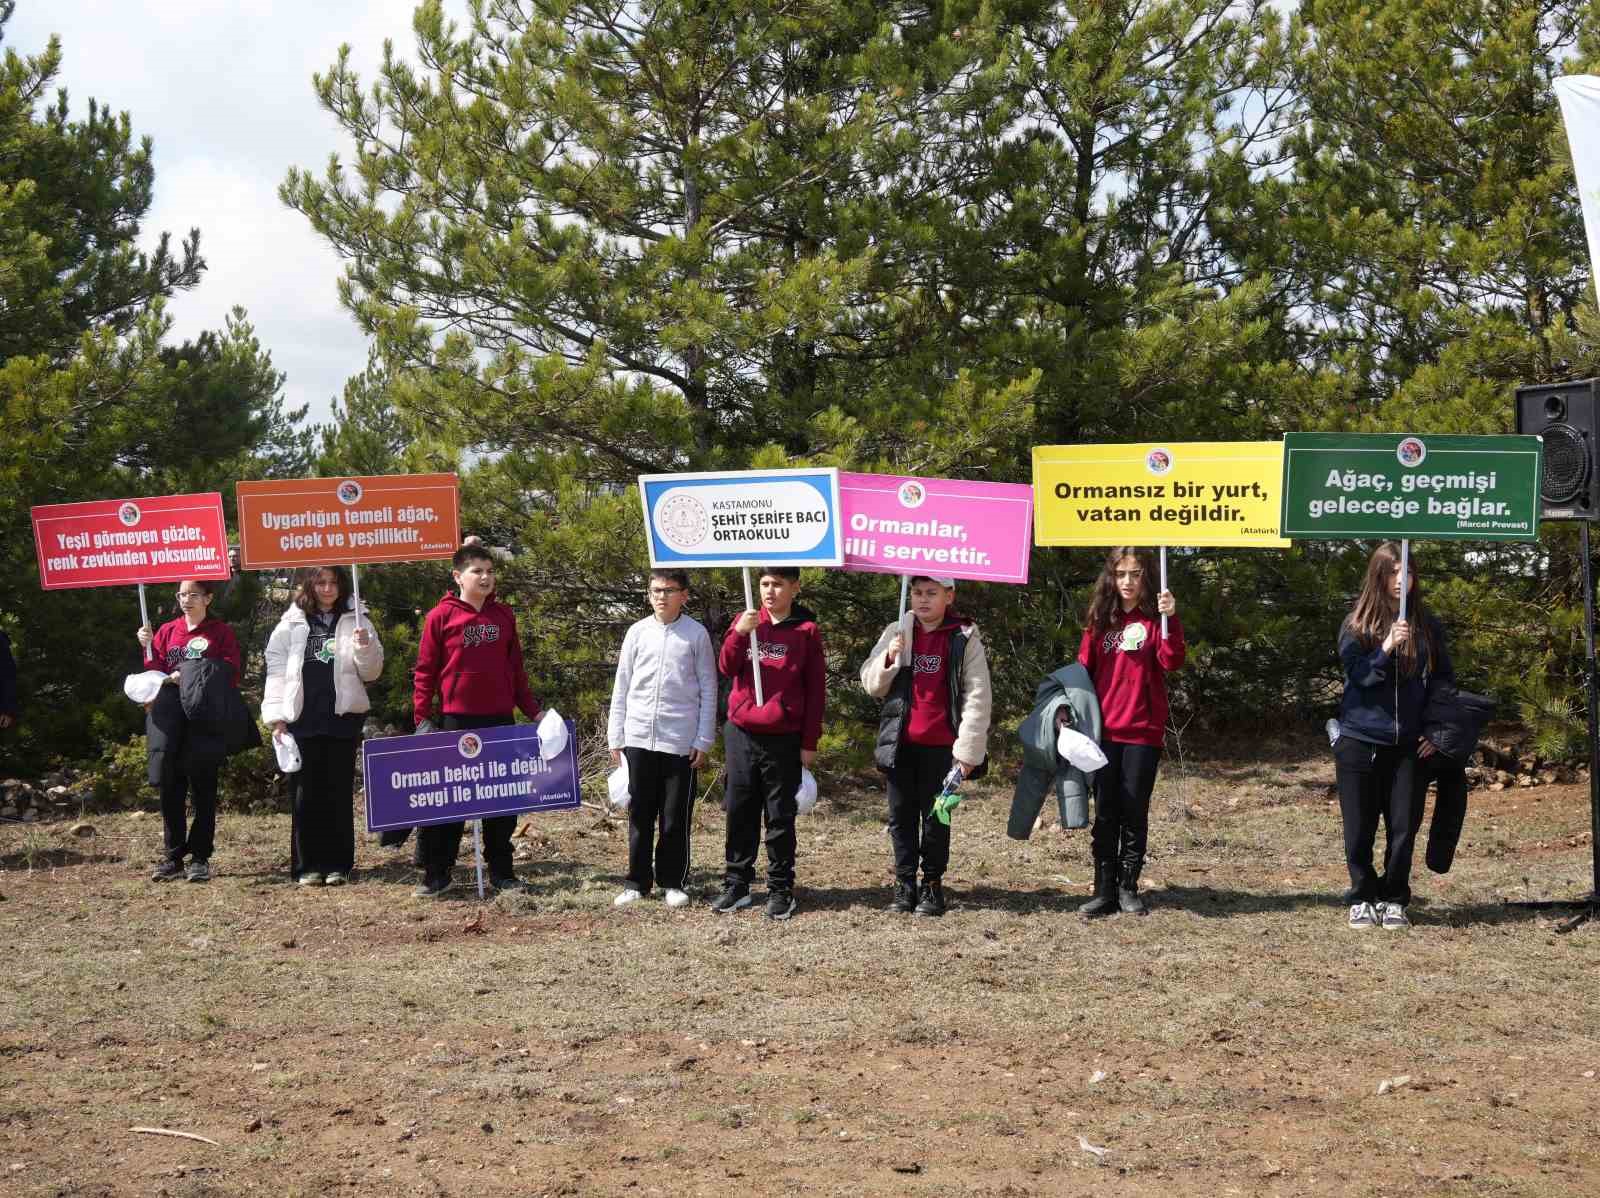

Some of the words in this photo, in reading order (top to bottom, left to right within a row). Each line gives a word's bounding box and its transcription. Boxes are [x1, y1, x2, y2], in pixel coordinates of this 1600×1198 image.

[1054, 483, 1165, 499] Ormansız
[1173, 481, 1204, 498] bir
[1212, 481, 1268, 501] yurt,
[1325, 469, 1393, 492] Ağaç,
[1400, 471, 1497, 493] geçmişi
[712, 499, 773, 510] KASTAMONU
[1077, 506, 1141, 522] vatan
[1149, 504, 1246, 525] değildir.
[1308, 496, 1420, 518] geleceğe
[1427, 497, 1511, 519] bağlar.
[261, 509, 340, 530] Uygarlığın
[344, 506, 393, 525] temeli
[397, 504, 439, 524] ağaç,
[711, 514, 747, 528] ŞEHİT
[750, 512, 793, 528] ŞERİFE
[796, 511, 826, 524] BACI
[850, 513, 968, 543] Ormanlar,
[56, 532, 91, 551] Yeşil
[93, 528, 159, 549] görmeyen
[161, 525, 206, 545] gözler,
[280, 532, 323, 551] çiçek
[326, 533, 345, 547] ve
[349, 527, 424, 547] yeşilliktir.
[713, 528, 790, 542] ORTAOKULU
[1240, 527, 1279, 535] (Atatürk)
[47, 555, 79, 571] renk
[81, 551, 148, 568] zevkinden
[150, 546, 220, 566] yoksundur.
[844, 538, 876, 558] illi
[883, 544, 992, 567] servettir.
[391, 770, 440, 789] Orman
[444, 762, 485, 784] bekçi
[488, 765, 507, 779] ile
[511, 756, 552, 775] değil,
[409, 787, 449, 808] sevgi
[452, 788, 472, 803] ile
[475, 780, 537, 801] korunur.
